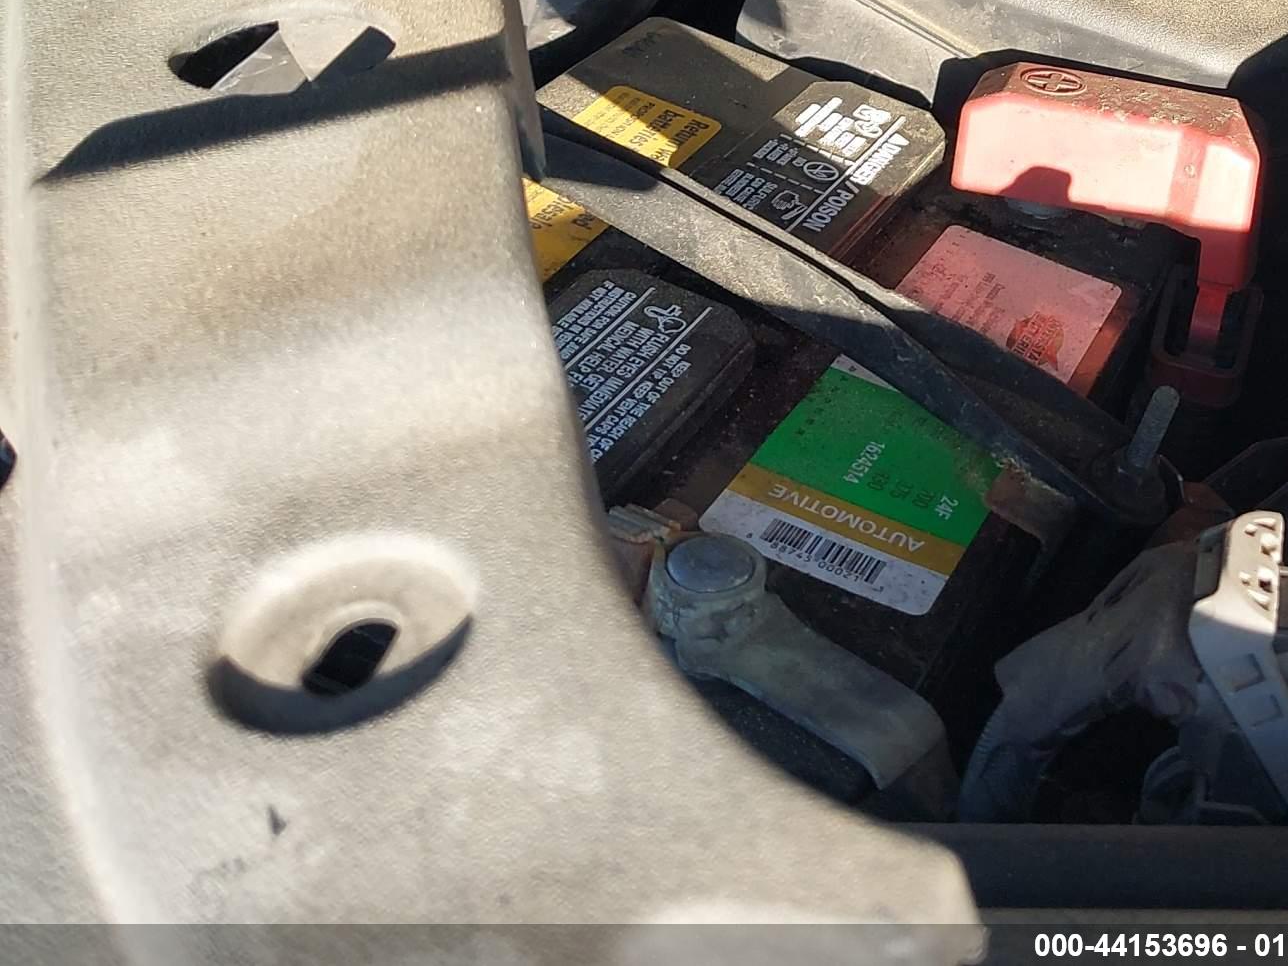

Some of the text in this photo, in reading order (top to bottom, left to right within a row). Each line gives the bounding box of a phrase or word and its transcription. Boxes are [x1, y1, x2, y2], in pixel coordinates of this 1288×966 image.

[629, 109, 685, 147] batteries
[664, 118, 710, 150] Return
[849, 140, 902, 187] DANGER
[801, 188, 854, 232] POISON
[588, 286, 606, 299] NOT
[590, 315, 610, 329] FOR
[573, 327, 597, 344] SAFE
[595, 319, 639, 355] MEDICAL
[625, 326, 654, 348] WITH
[635, 332, 670, 360] FLUSH
[674, 342, 691, 355] DO
[576, 350, 605, 373] HELP
[615, 356, 645, 379] EYES
[660, 352, 680, 369] NOT
[579, 371, 604, 391] GET
[630, 380, 654, 399] KEEP
[595, 360, 691, 450] KEEP OUT OF THE REACH OF
[613, 397, 636, 416] VENT
[594, 414, 619, 434] CAPS
[842, 441, 886, 484] 1624514
[767, 482, 925, 552] AUTOMOTIVE
[932, 494, 960, 520] 24F
